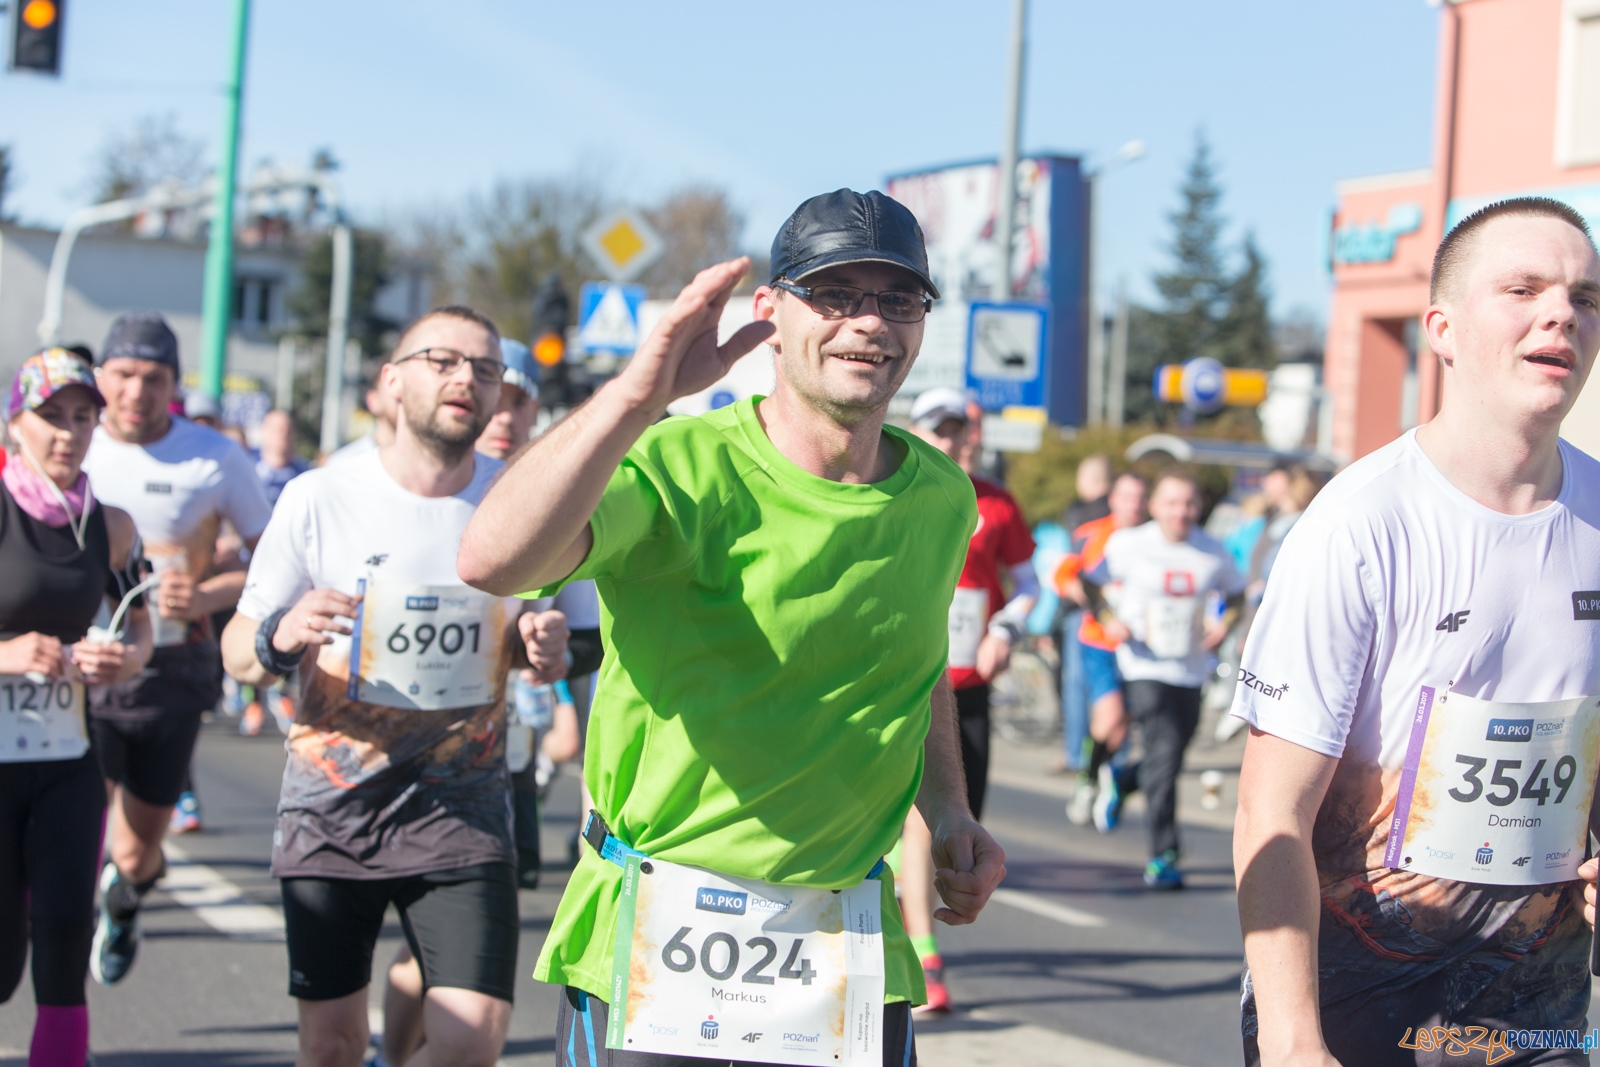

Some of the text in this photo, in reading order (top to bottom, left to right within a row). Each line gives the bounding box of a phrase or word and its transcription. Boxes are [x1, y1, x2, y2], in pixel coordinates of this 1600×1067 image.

[1577, 600, 1600, 611] 10. PK
[1436, 610, 1470, 633] 4F
[387, 621, 481, 655] 6901
[1, 681, 73, 712] 1270
[1416, 691, 1428, 723] 26.03.2017
[1493, 725, 1529, 736] 10. PKO
[1448, 754, 1577, 807] 3549
[1488, 814, 1541, 828] Damian
[1387, 835, 1397, 862] Matysiak
[1512, 857, 1531, 867] 4F
[625, 863, 635, 896] 26.03.2017
[701, 893, 743, 909] 10. PKO
[661, 926, 817, 986] 6024
[711, 987, 767, 1004] Markus
[741, 1032, 763, 1043] 4F
